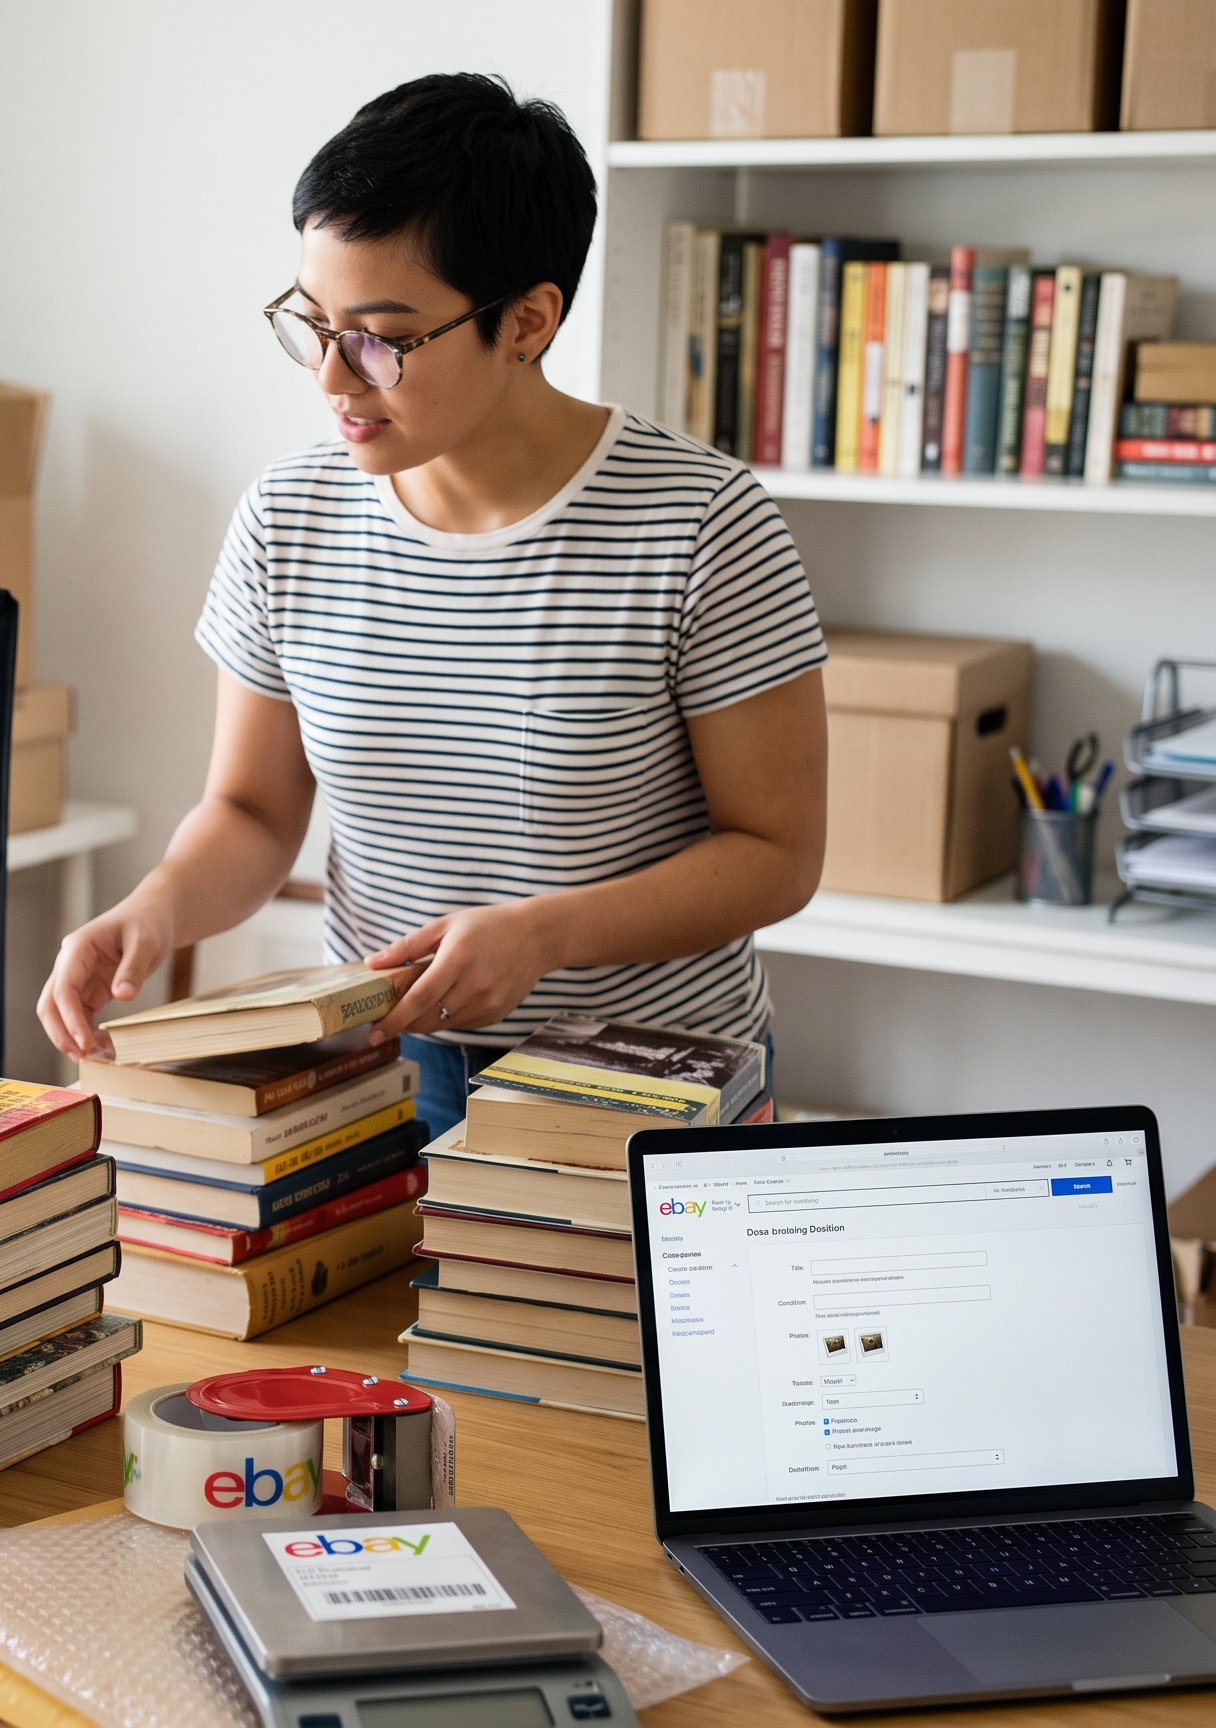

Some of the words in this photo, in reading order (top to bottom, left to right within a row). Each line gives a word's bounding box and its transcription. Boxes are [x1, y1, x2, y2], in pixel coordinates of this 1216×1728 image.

[659, 1198, 707, 1217] ebay
[810, 1224, 844, 1233] Dosition
[285, 1534, 431, 1558] ebay
